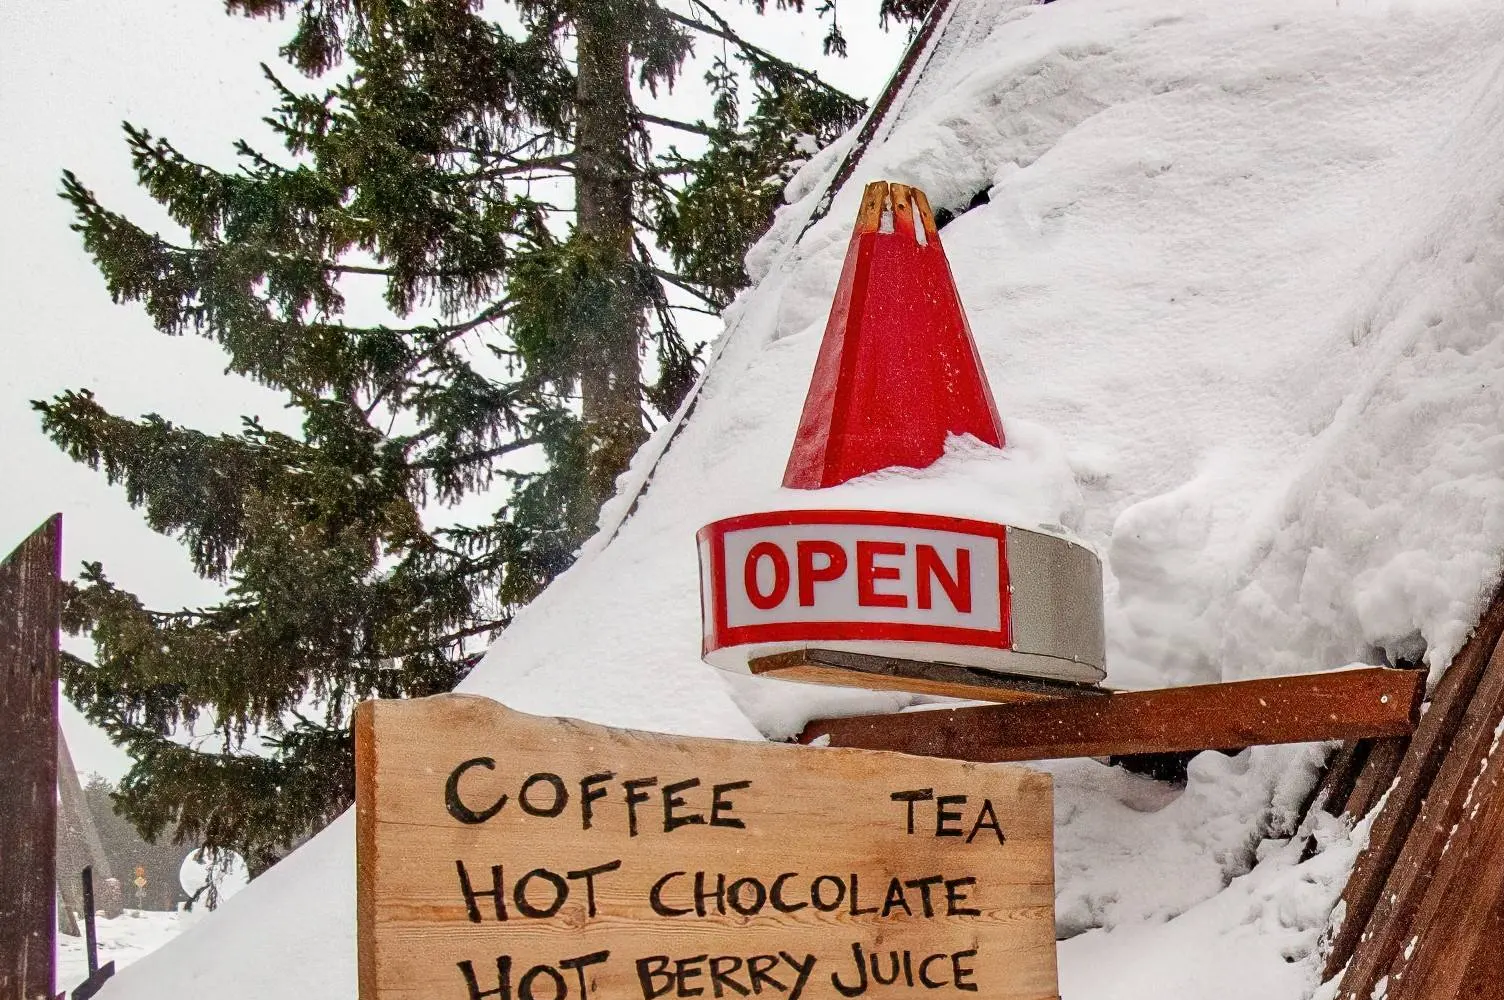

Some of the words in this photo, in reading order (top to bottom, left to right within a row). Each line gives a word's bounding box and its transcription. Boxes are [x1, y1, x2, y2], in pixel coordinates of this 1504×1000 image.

[743, 540, 972, 613] OPEN
[444, 756, 753, 837] COFFEE
[890, 787, 1006, 845] TEA
[455, 859, 622, 923] HOT
[649, 870, 982, 919] CHOCOLATE
[830, 941, 979, 999] JUICE
